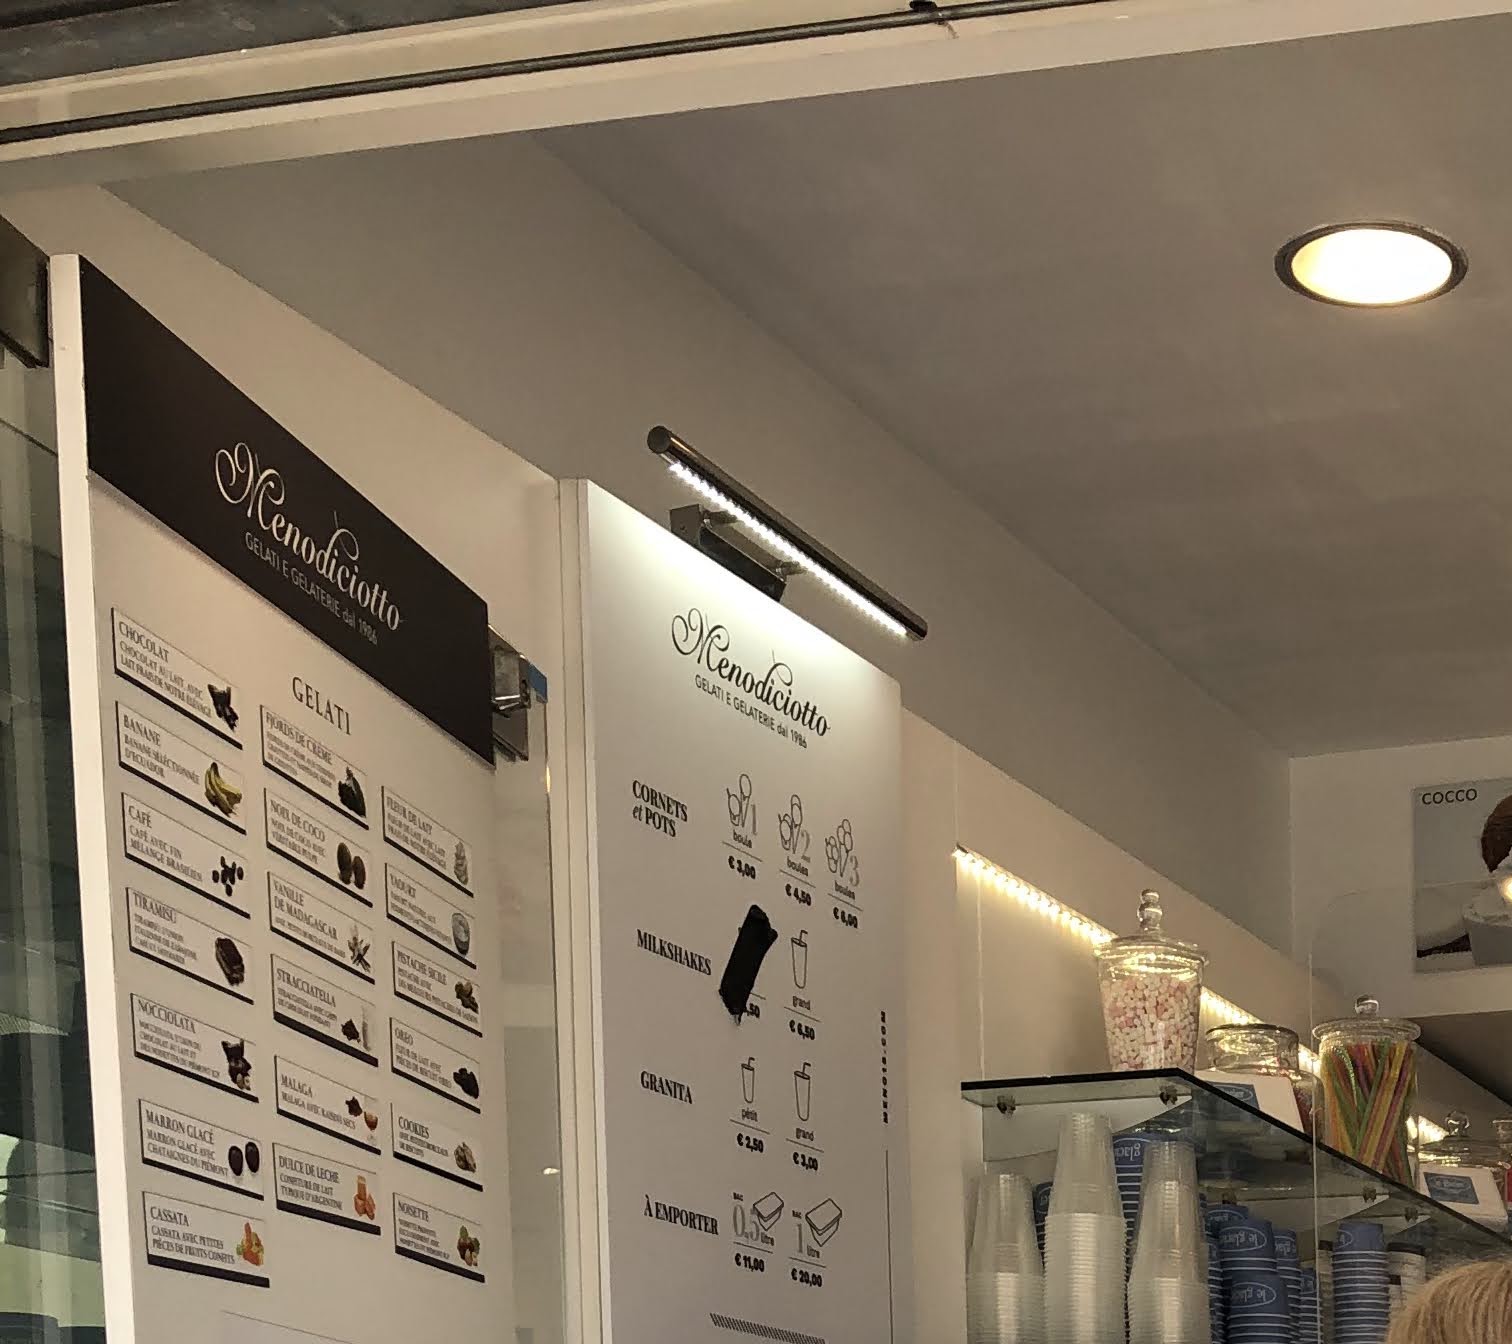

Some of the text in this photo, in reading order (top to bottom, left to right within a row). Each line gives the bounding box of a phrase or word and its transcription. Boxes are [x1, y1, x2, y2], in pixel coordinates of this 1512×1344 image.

[245, 531, 280, 571] GELATI
[282, 562, 289, 578] E
[291, 567, 340, 618] GELATERIE
[118, 620, 169, 663] CHOCOLAT
[671, 607, 828, 737] Menodiciotto
[292, 676, 352, 736] GELATI
[694, 673, 808, 750] GELATI E GELATERIE dal 1986
[123, 714, 161, 748] BANANE
[632, 779, 689, 823] CORNETS
[1421, 786, 1478, 805] cocco
[632, 804, 677, 838] et POTS
[727, 854, 757, 880] € 3,00
[786, 855, 810, 877] boules
[784, 883, 812, 907] € 4,50
[286, 903, 338, 941] MADAGASCAR
[832, 906, 858, 929] € 6,00
[636, 929, 712, 976] MILKSHAKES
[276, 968, 337, 1008] STRACCIATELLA
[137, 998, 196, 1034] NOCCIOLATA
[788, 1019, 816, 1041] € 6,50
[281, 1074, 313, 1099] MALAGA
[640, 1070, 693, 1105] GRANITA
[145, 1109, 215, 1145] MARRON GLACÉ
[398, 1116, 430, 1140] COOKIES
[795, 1127, 815, 1142] grand
[736, 1133, 764, 1153] € 2,50
[279, 1155, 340, 1184] DULCE DE LECHE
[792, 1151, 819, 1171] € 3,00
[732, 1192, 744, 1202] BAC
[150, 1206, 190, 1228] CASSATA
[643, 1194, 719, 1236] À EMPORTER
[791, 1209, 802, 1219] BAC
[734, 1252, 765, 1273] € 11,00
[790, 1267, 823, 1288] € 20,00
